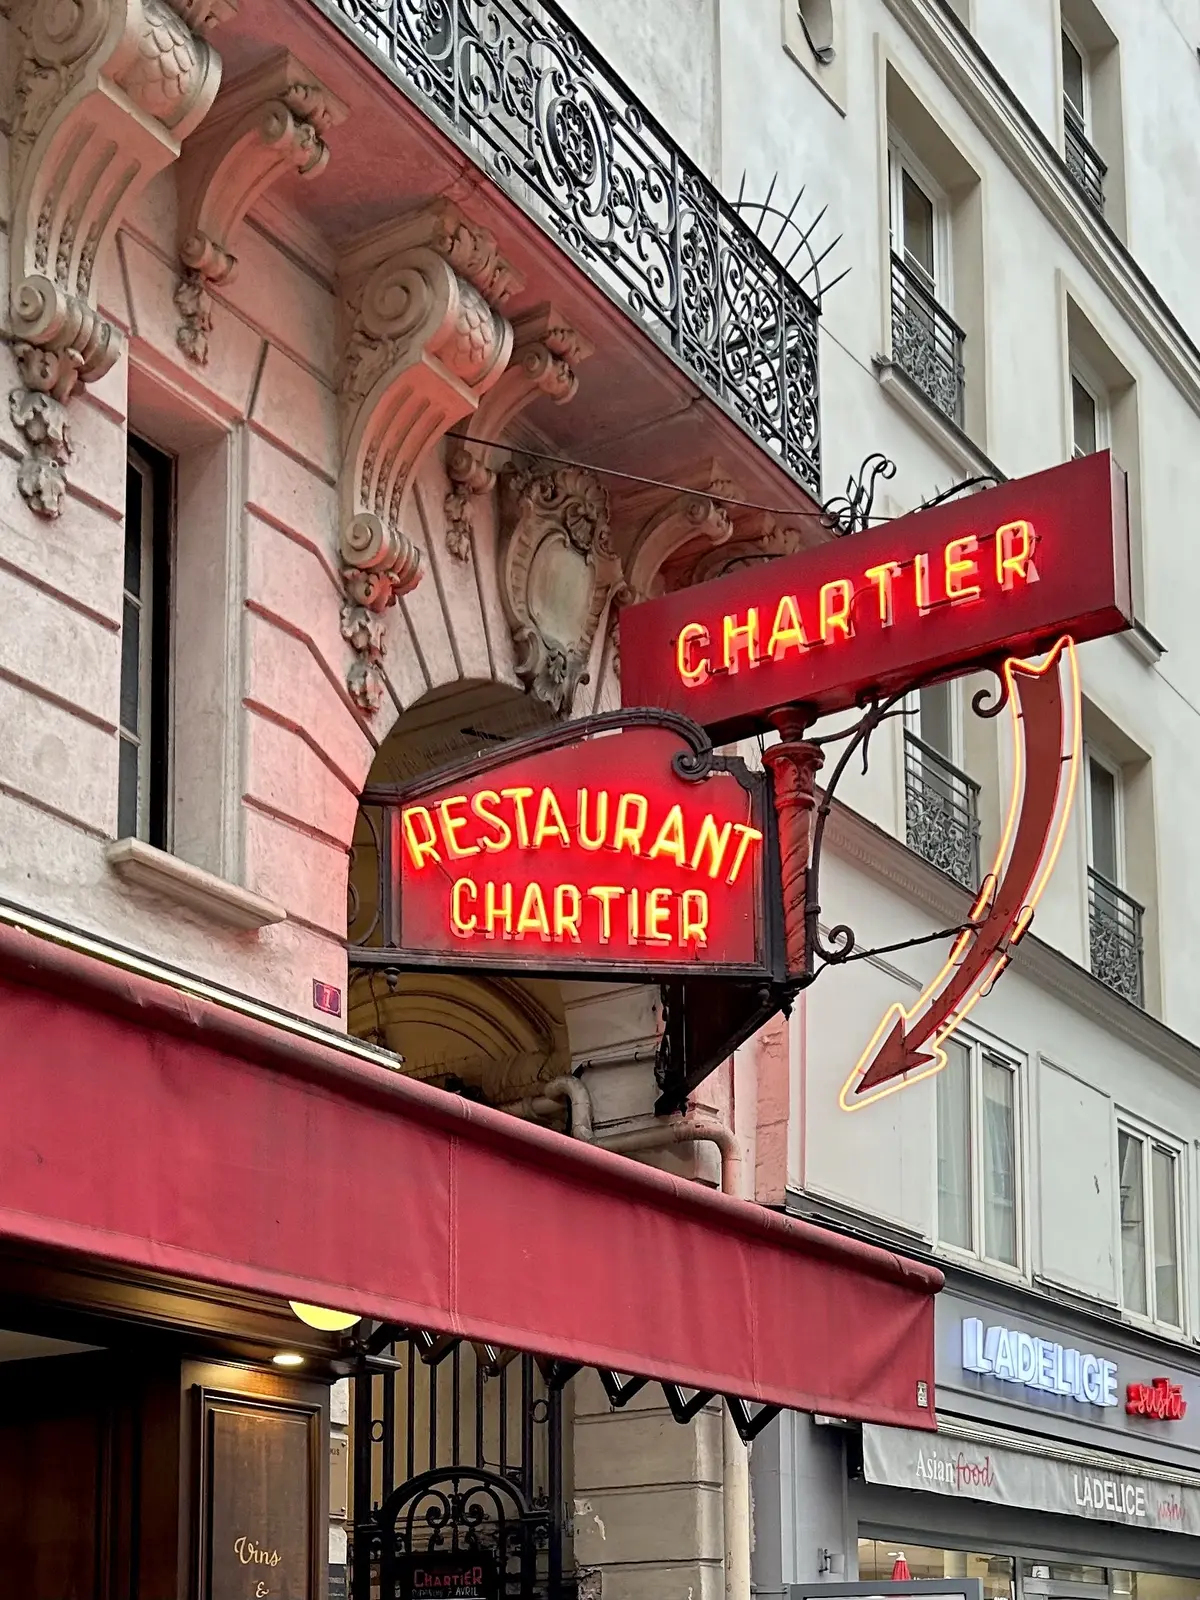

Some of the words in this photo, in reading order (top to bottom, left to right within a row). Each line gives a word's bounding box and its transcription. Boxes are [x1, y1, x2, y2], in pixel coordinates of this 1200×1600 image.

[677, 520, 1040, 688] CHARTIER
[402, 786, 763, 885] RESTAURANT
[450, 877, 708, 948] CHARTIER
[963, 1317, 1119, 1408] LADELICE
[1125, 1377, 1187, 1421] sushi
[915, 1449, 955, 1485] Asian
[956, 1451, 995, 1492] food
[1073, 1474, 1146, 1517] LADELICE
[234, 1536, 281, 1567] Vins
[255, 1581, 270, 1598] &
